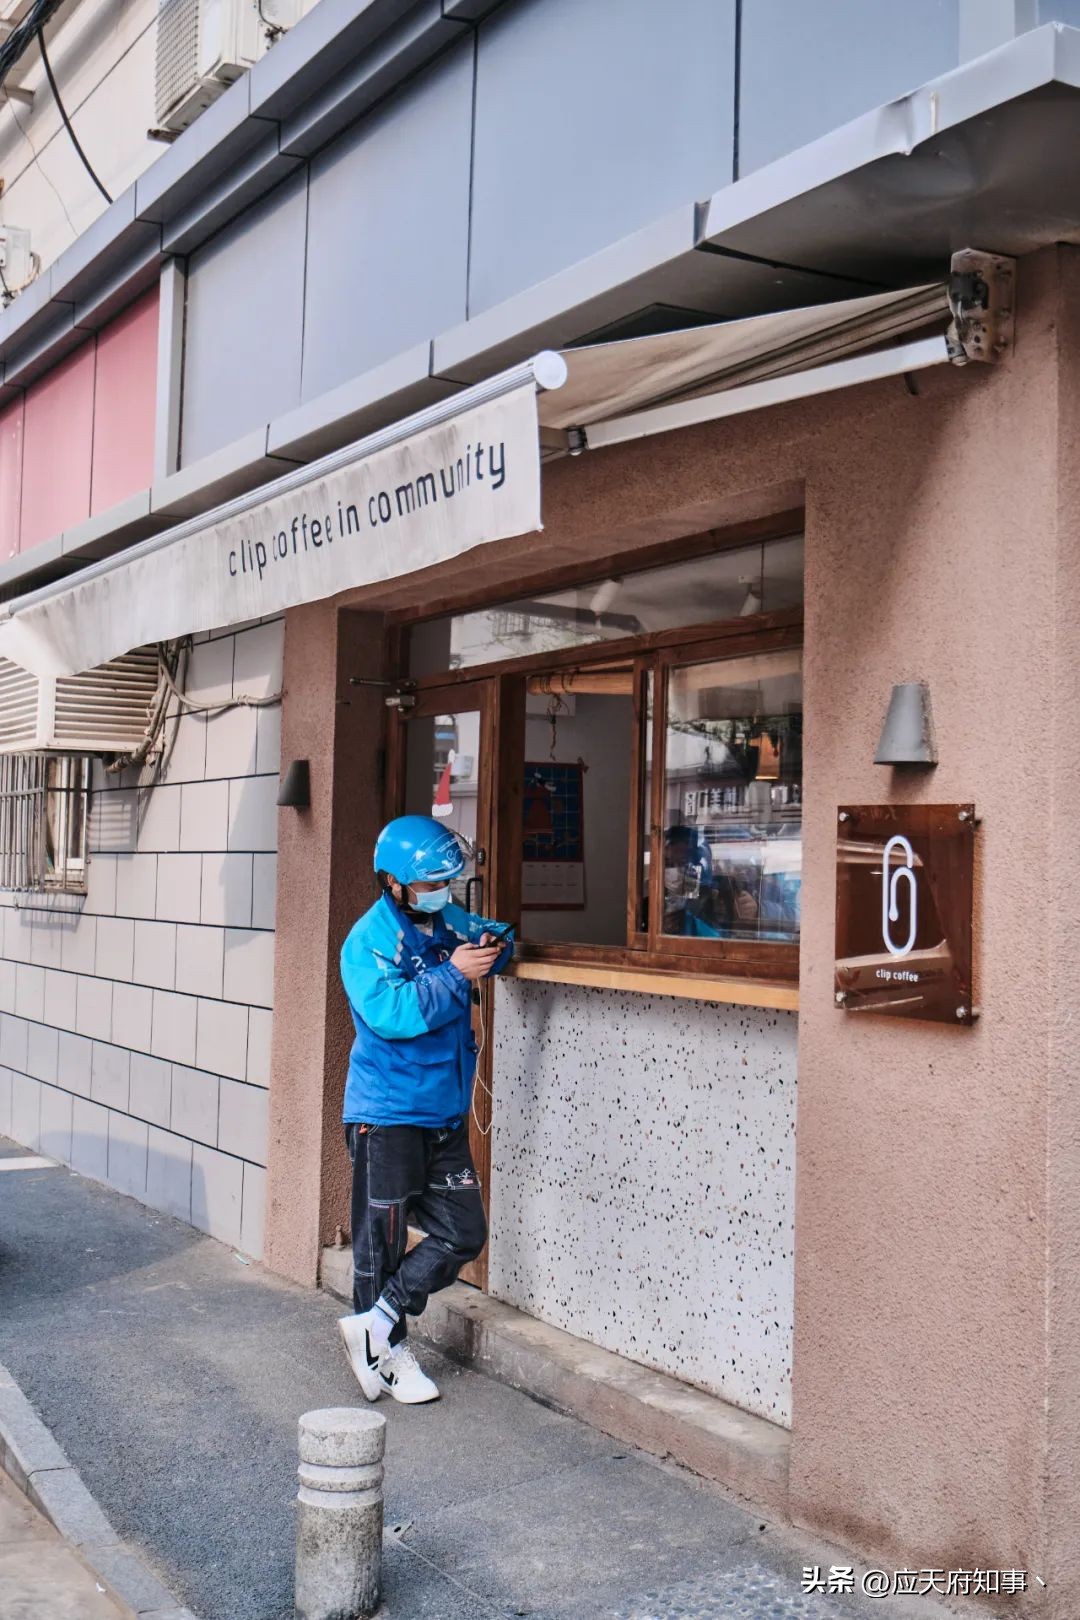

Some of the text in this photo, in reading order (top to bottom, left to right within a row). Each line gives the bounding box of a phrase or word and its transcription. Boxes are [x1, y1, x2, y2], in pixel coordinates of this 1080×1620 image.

[229, 441, 506, 580] clip coffee in community
[875, 968, 918, 982] clip coffee
